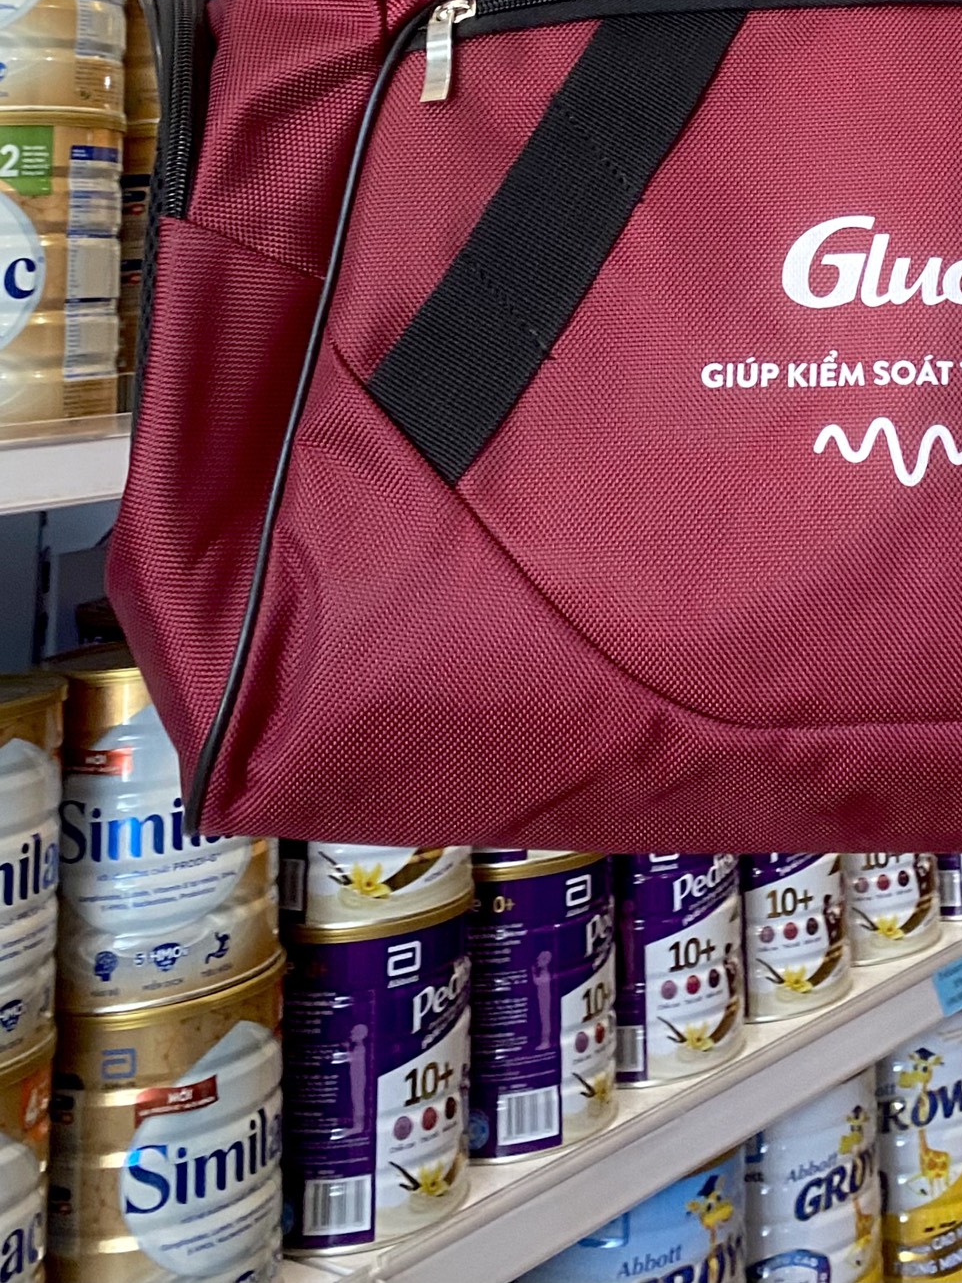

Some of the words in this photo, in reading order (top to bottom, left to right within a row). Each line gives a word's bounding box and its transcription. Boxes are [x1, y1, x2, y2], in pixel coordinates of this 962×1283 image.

[701, 357, 780, 389] GIÚP
[787, 349, 866, 388] KIỂM
[873, 355, 954, 386] SOÁT
[766, 887, 813, 919] 10+
[669, 937, 716, 973] 10+
[404, 1061, 454, 1108] 10+
[616, 1243, 683, 1280] Abbott
